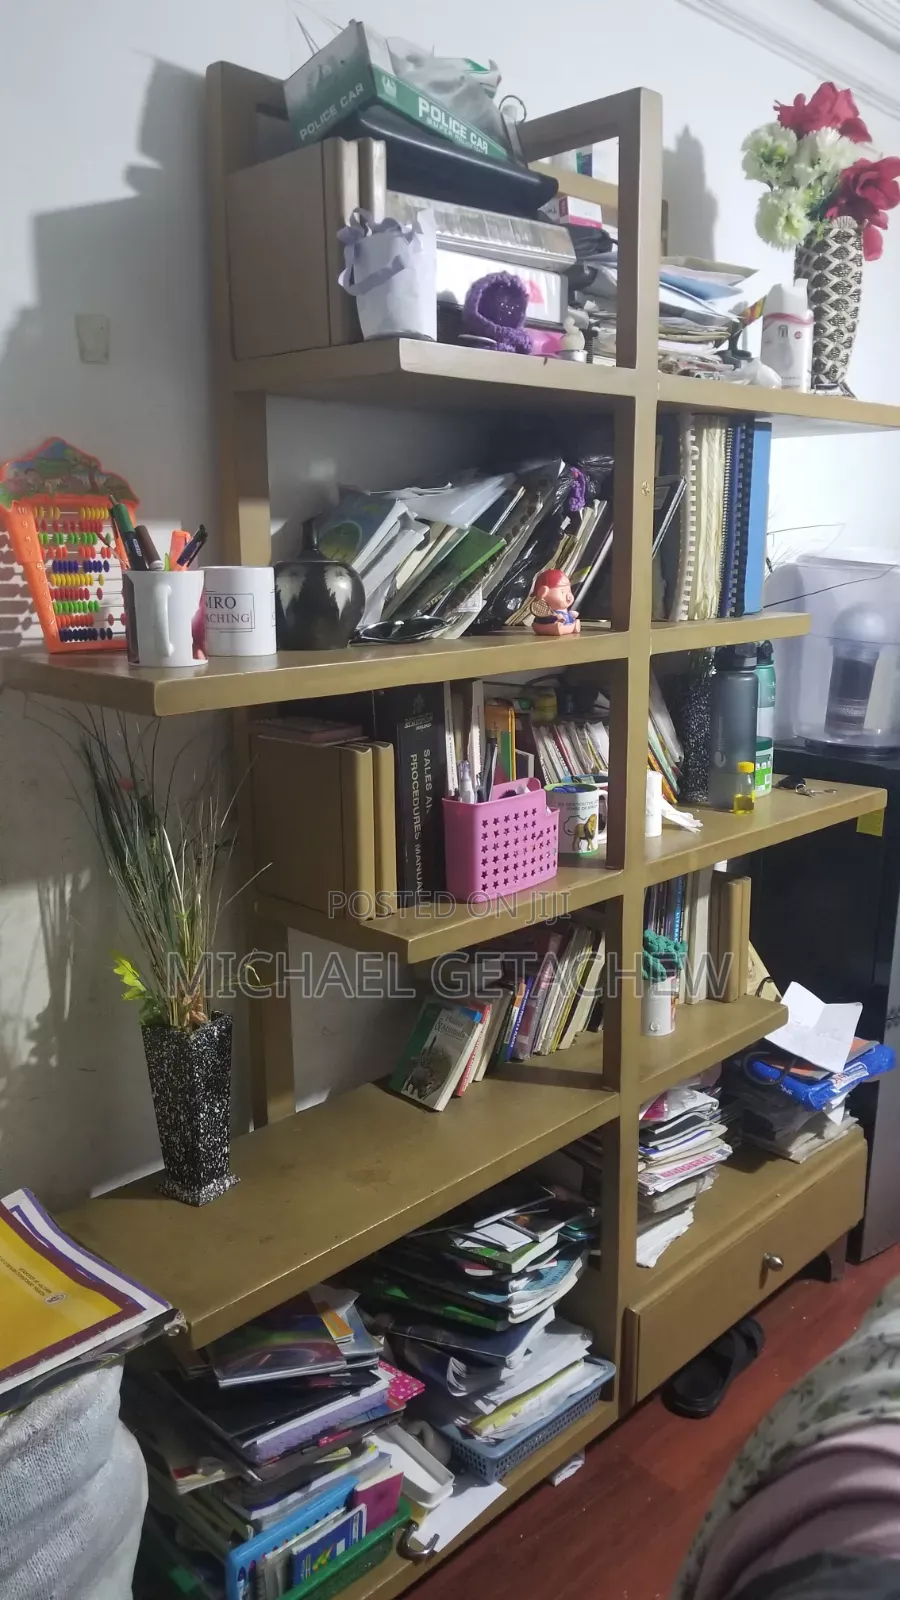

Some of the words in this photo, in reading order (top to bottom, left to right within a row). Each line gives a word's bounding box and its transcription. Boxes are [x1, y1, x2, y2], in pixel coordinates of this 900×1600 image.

[300, 104, 338, 141] POLICE
[340, 82, 364, 108] CAR
[418, 96, 468, 140] POLICE
[470, 131, 488, 155] CAR
[410, 753, 422, 840] PROCEDURES
[423, 748, 433, 791] SALES
